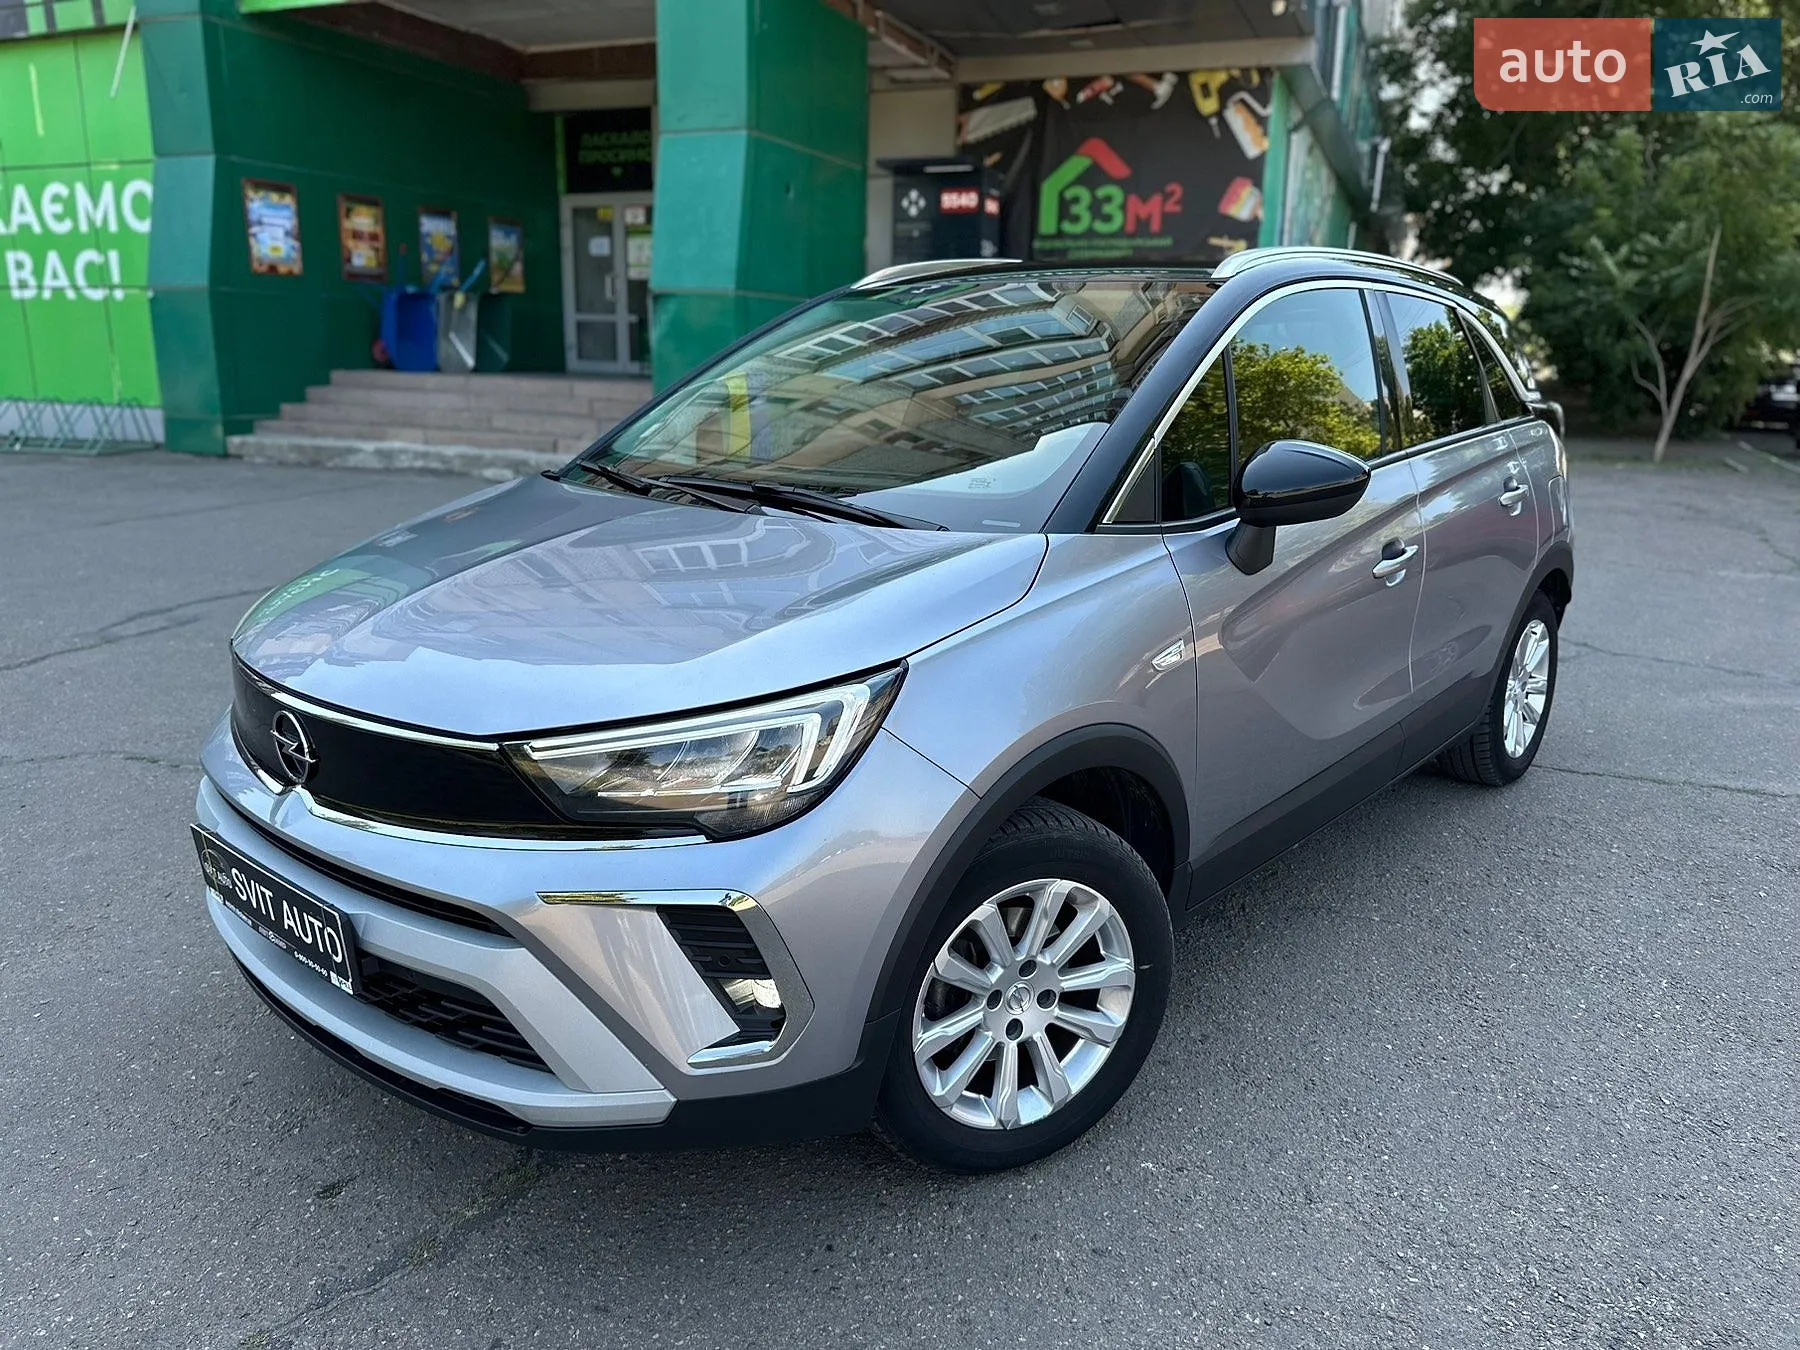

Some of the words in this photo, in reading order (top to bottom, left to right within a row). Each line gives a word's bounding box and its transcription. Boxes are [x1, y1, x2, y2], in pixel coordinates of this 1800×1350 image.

[0, 179, 153, 235] АЄМО
[5, 249, 125, 301] ВАС!
[231, 867, 276, 921] SVIT
[282, 899, 343, 963] AUTO
